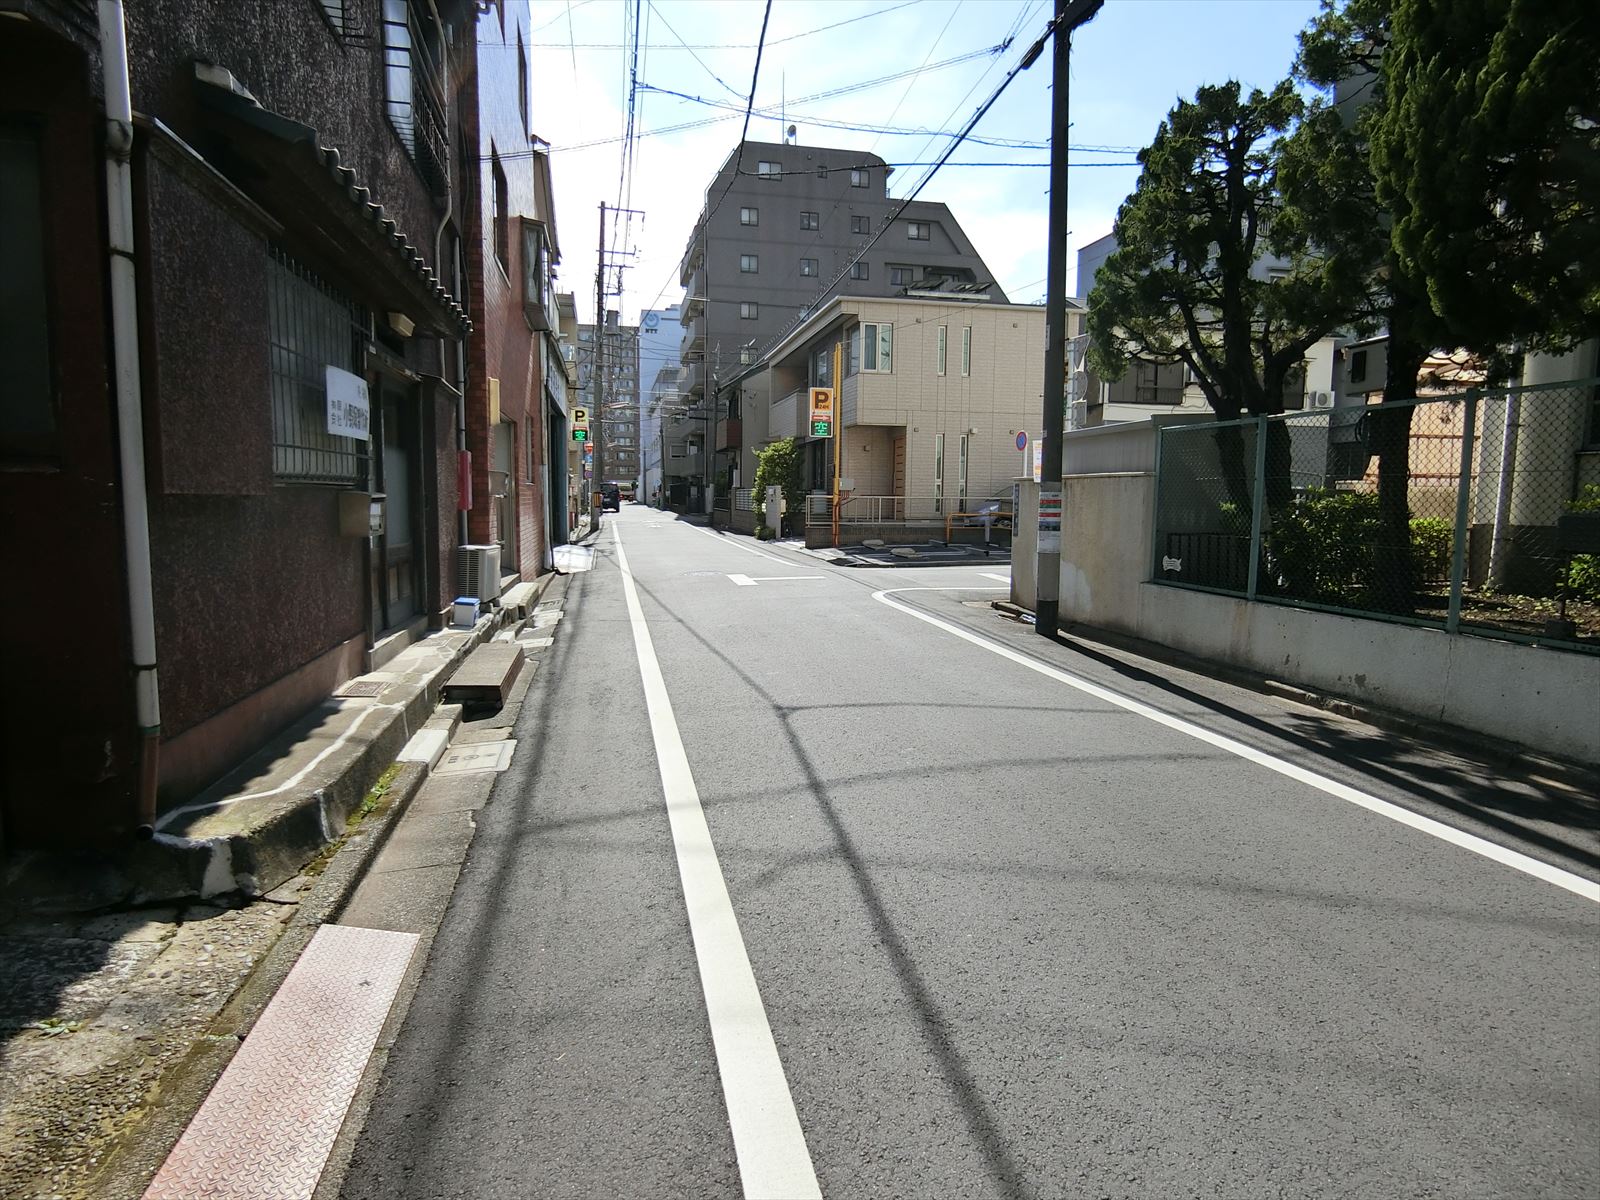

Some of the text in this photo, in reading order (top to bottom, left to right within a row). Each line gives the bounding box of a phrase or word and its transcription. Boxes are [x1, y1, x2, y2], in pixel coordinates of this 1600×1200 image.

[815, 391, 829, 409] P
[575, 410, 586, 422] P
[814, 421, 828, 435] 空
